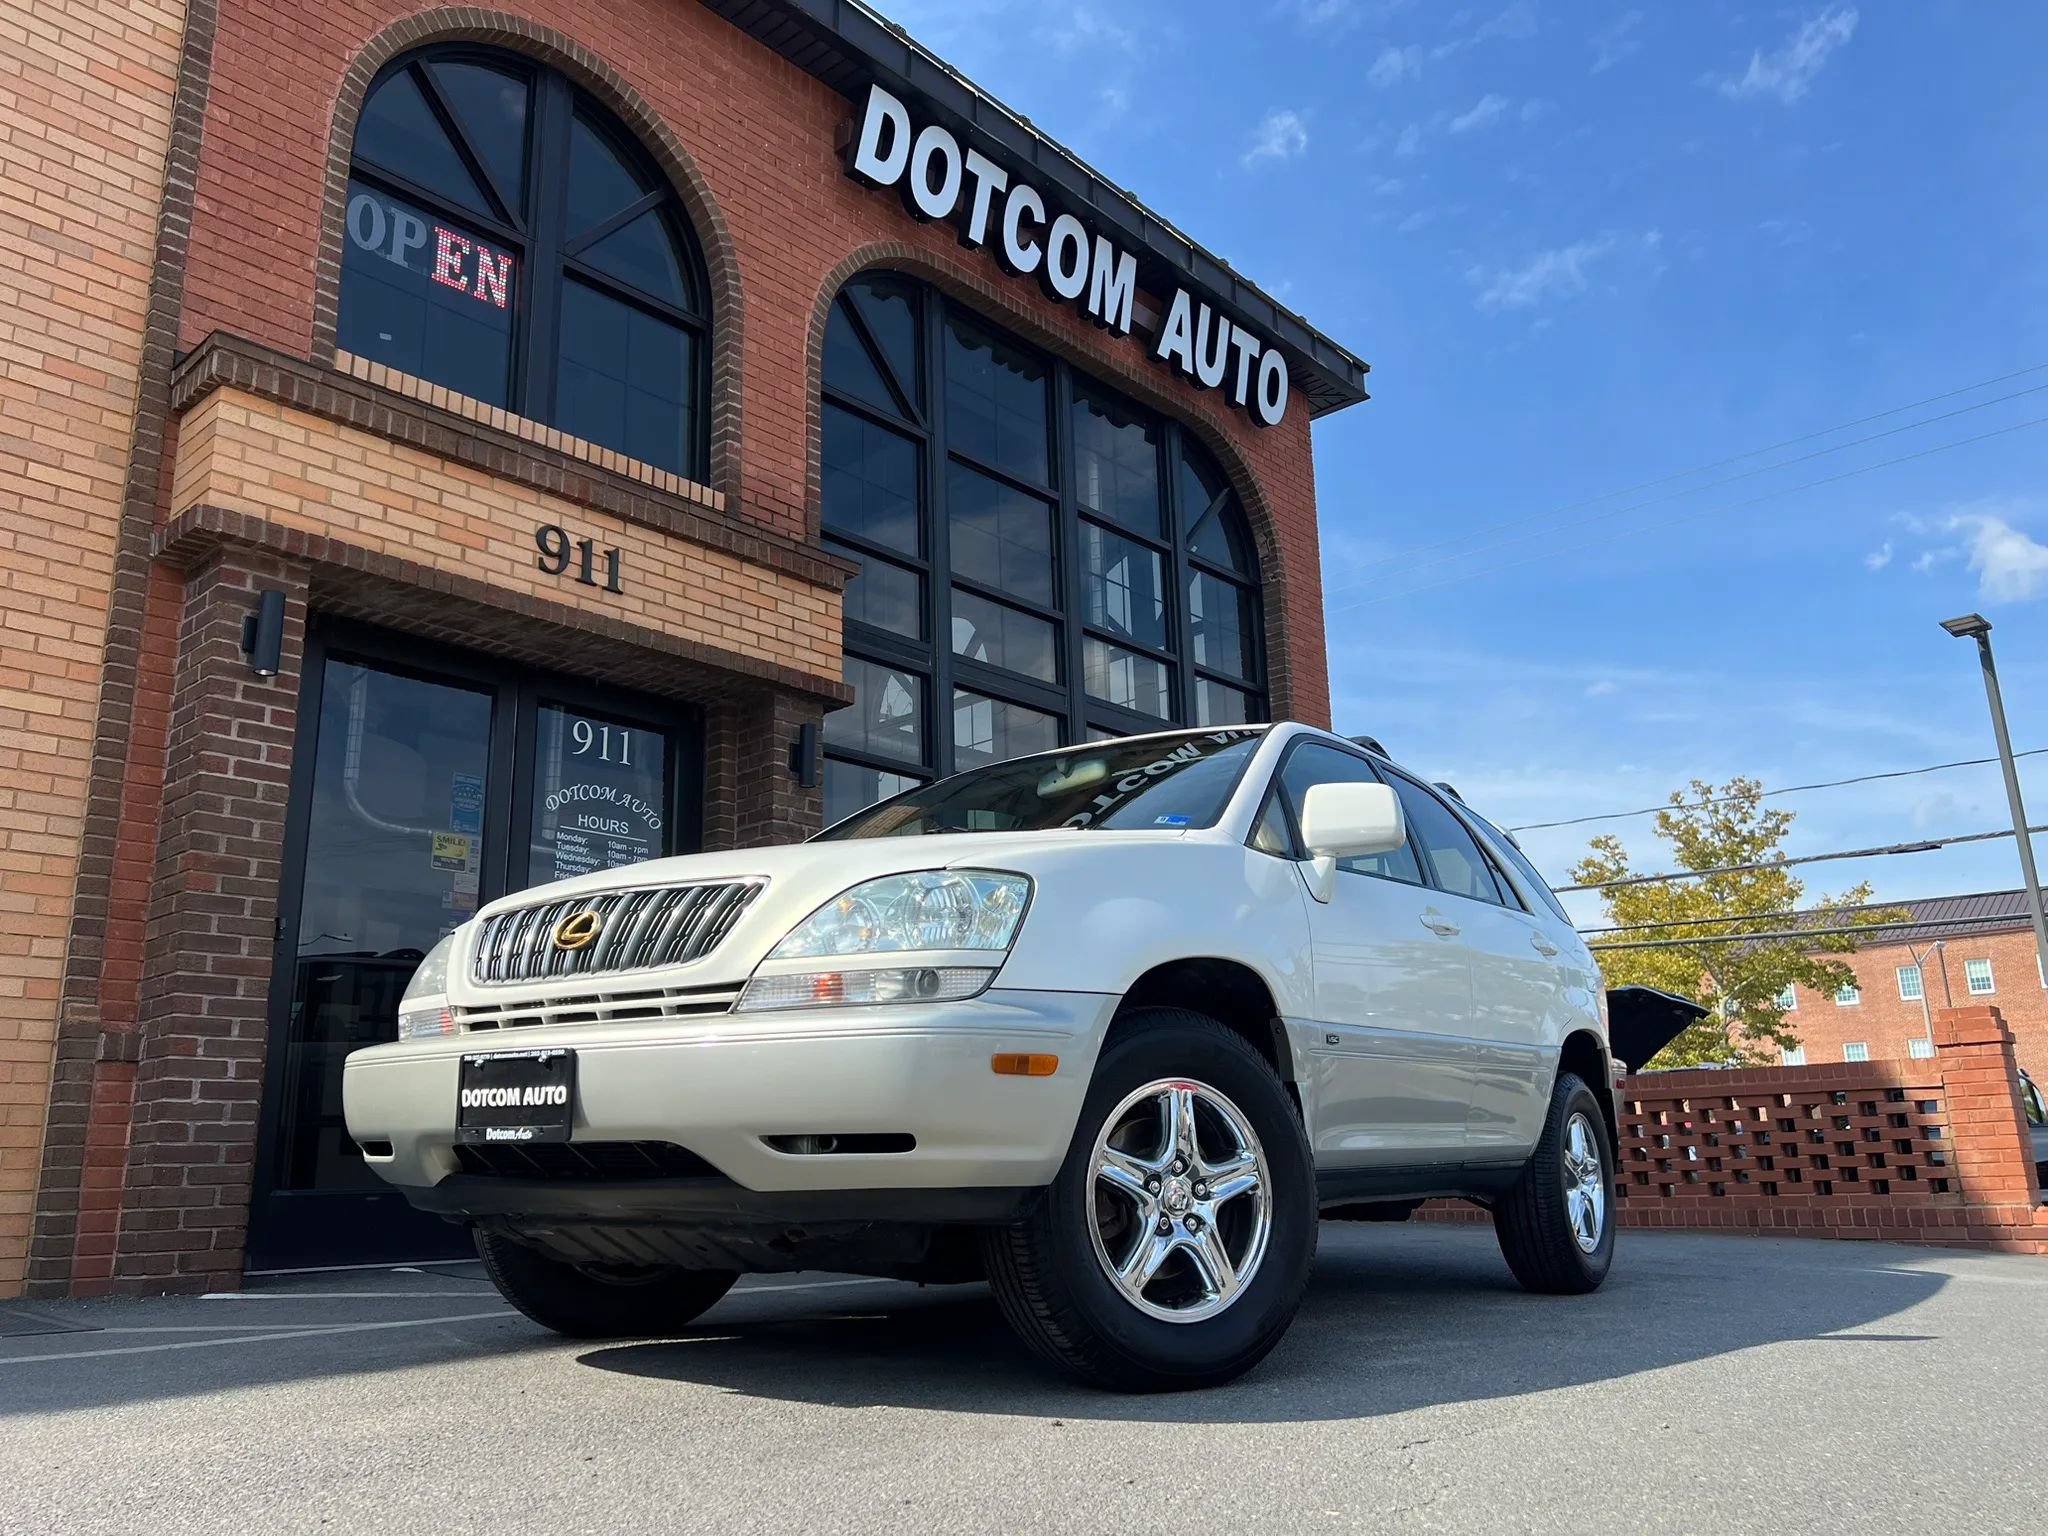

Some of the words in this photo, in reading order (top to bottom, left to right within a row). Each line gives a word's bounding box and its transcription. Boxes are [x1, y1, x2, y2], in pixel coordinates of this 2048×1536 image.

[346, 194, 512, 308] OPEN
[854, 83, 1138, 335] DOTCOM
[1156, 288, 1289, 426] AUTO
[535, 524, 624, 595] 911
[571, 720, 631, 766] 911
[545, 783, 617, 811] DOTCOM
[615, 793, 661, 830] AUTO
[577, 814, 629, 834] HOURS
[607, 840, 628, 851] 10am
[607, 850, 627, 860] 10am
[461, 1088, 521, 1107] DOTCOM
[522, 1086, 567, 1106] AUTO
